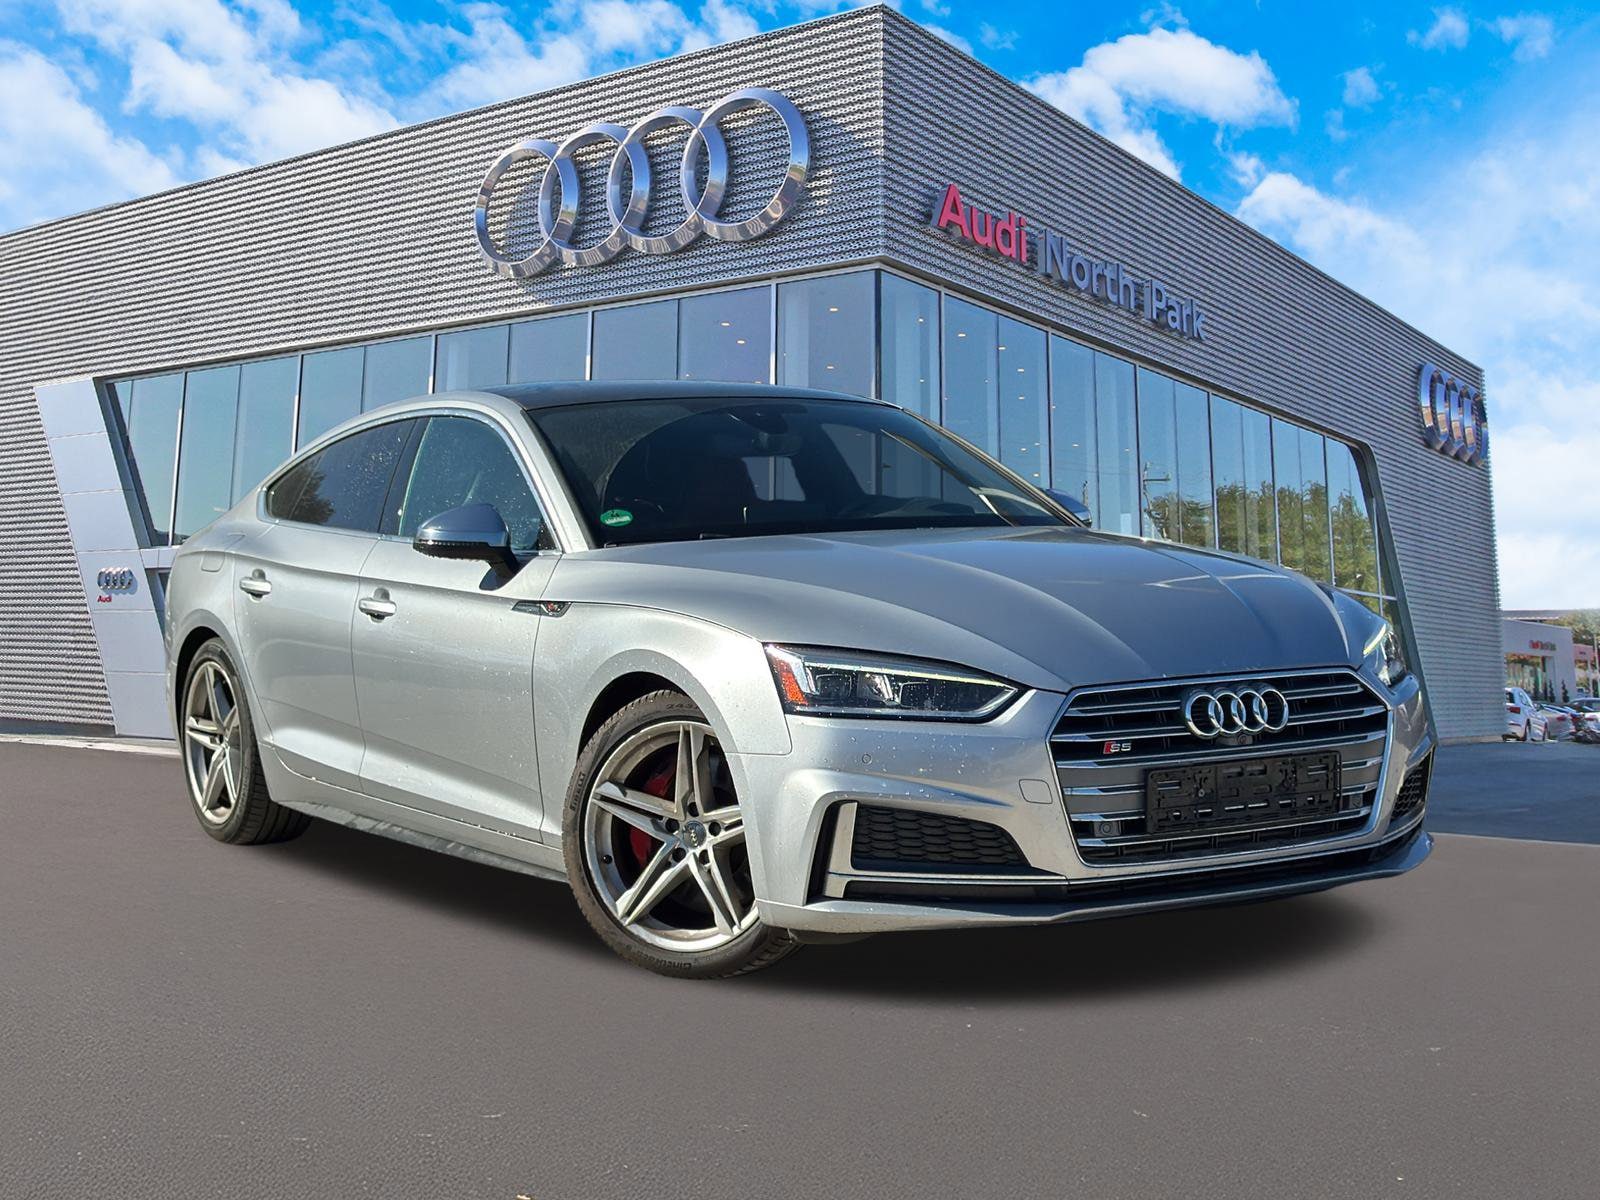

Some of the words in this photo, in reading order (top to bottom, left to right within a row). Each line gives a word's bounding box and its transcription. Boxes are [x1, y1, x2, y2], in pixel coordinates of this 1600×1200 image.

[935, 183, 1027, 262] Audi
[1038, 230, 1135, 310] North
[1145, 280, 1207, 341] Park
[97, 595, 112, 603] Audi
[1107, 741, 1131, 754] S5
